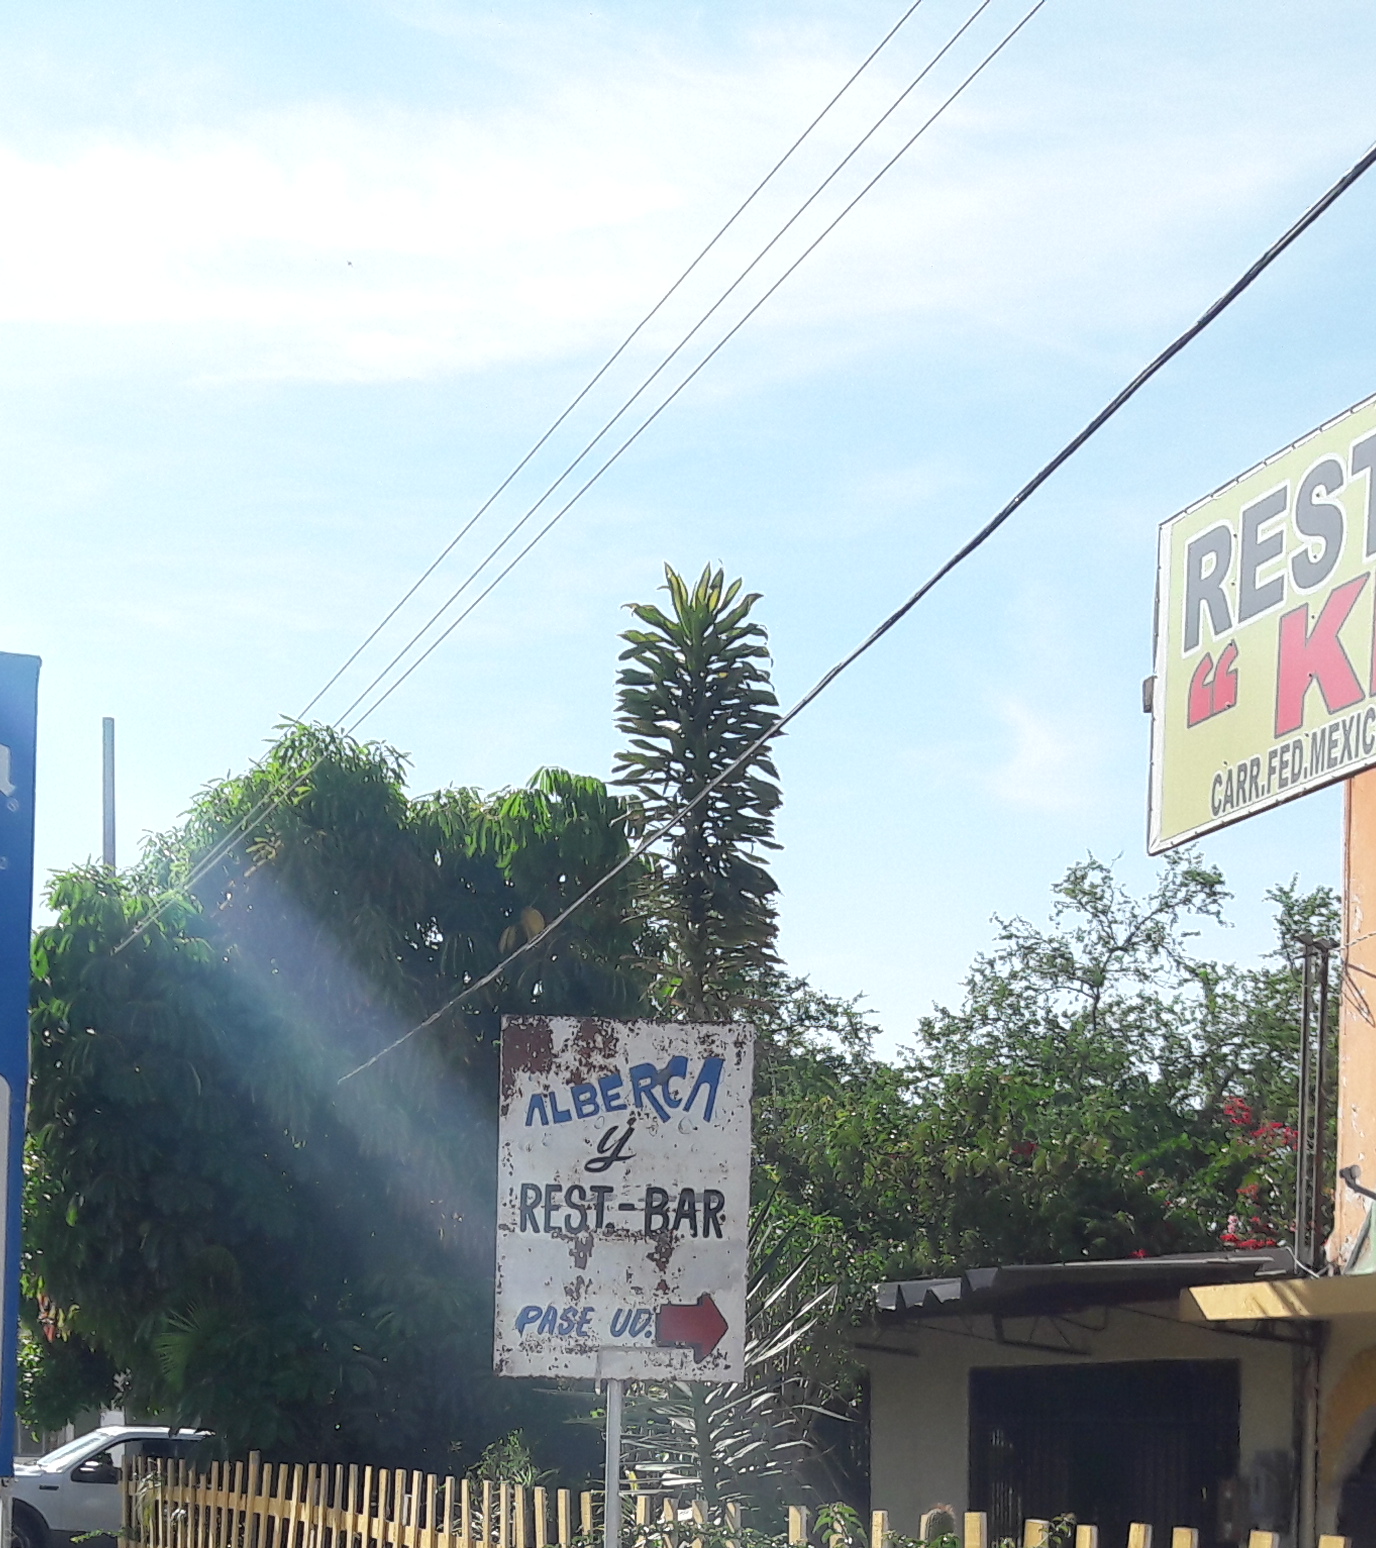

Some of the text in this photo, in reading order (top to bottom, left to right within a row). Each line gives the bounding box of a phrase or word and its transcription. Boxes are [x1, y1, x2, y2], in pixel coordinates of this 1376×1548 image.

[525, 1056, 725, 1127] ALBERCA
[515, 1305, 654, 1339] PASE UD.
